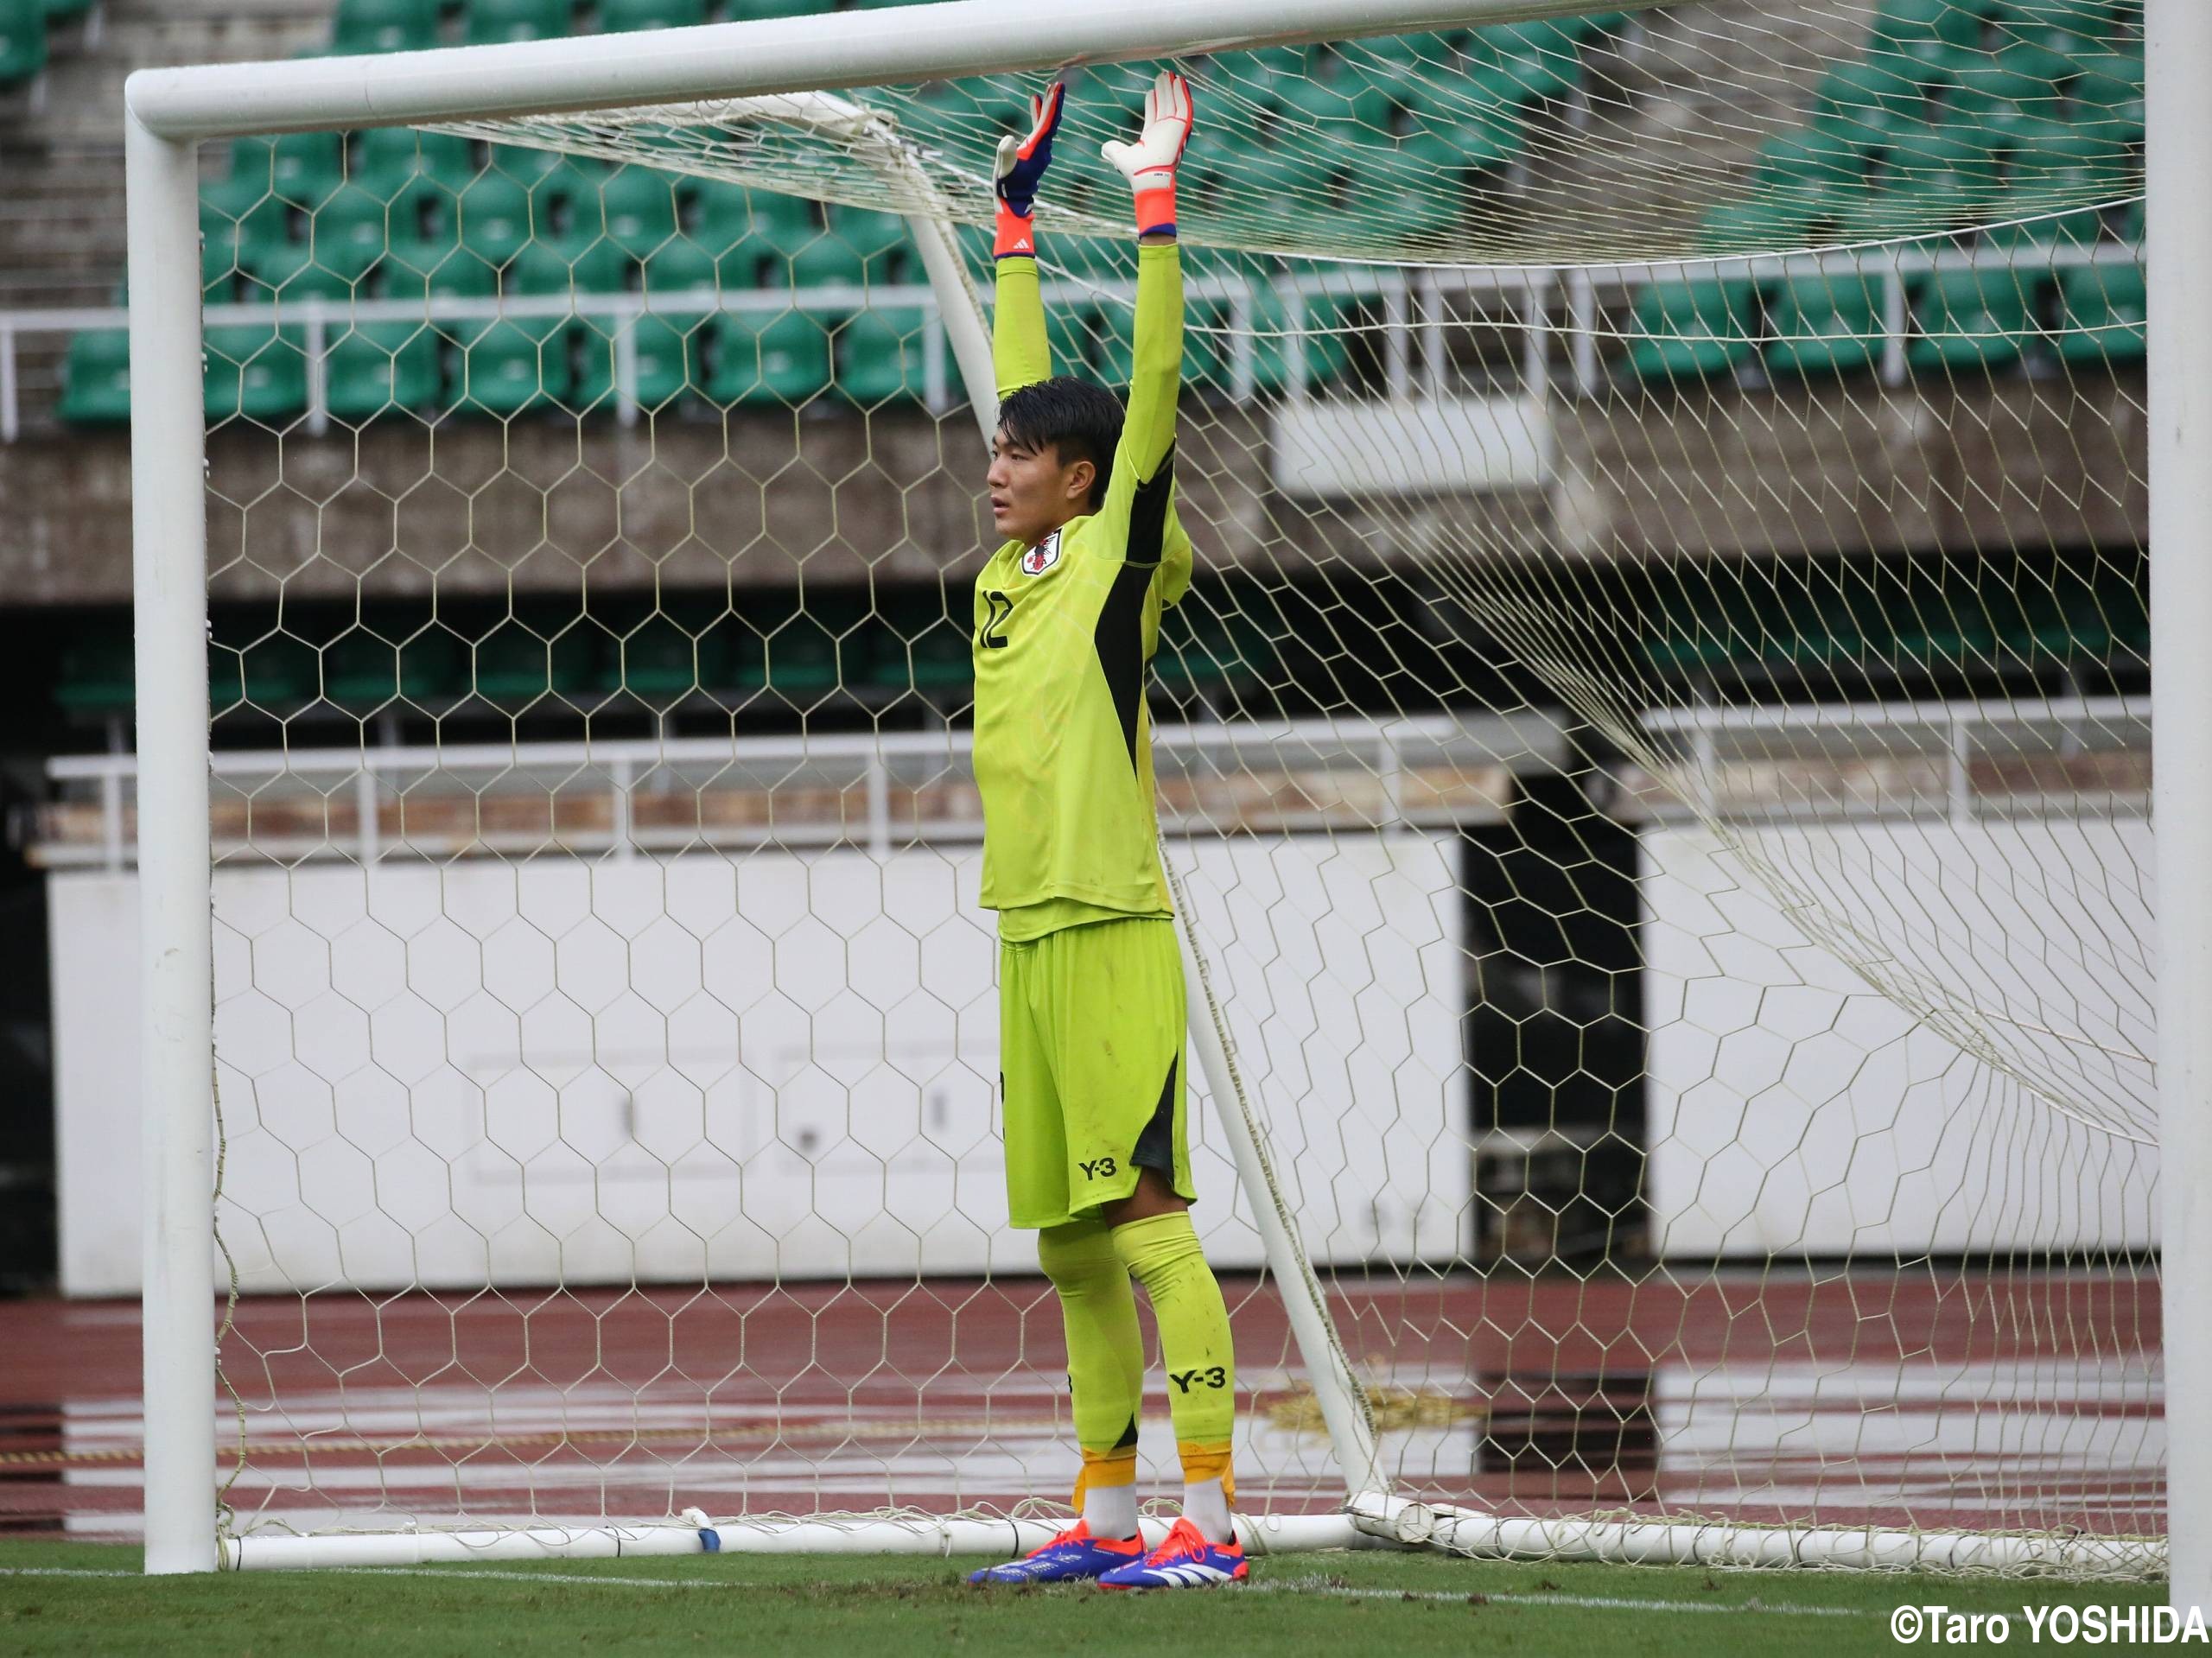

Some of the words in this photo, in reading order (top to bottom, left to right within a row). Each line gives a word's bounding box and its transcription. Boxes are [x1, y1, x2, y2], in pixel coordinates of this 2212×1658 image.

[980, 590, 1014, 649] 12
[1078, 1157, 1116, 1181] Y-3
[1169, 1366, 1226, 1394] Y-3
